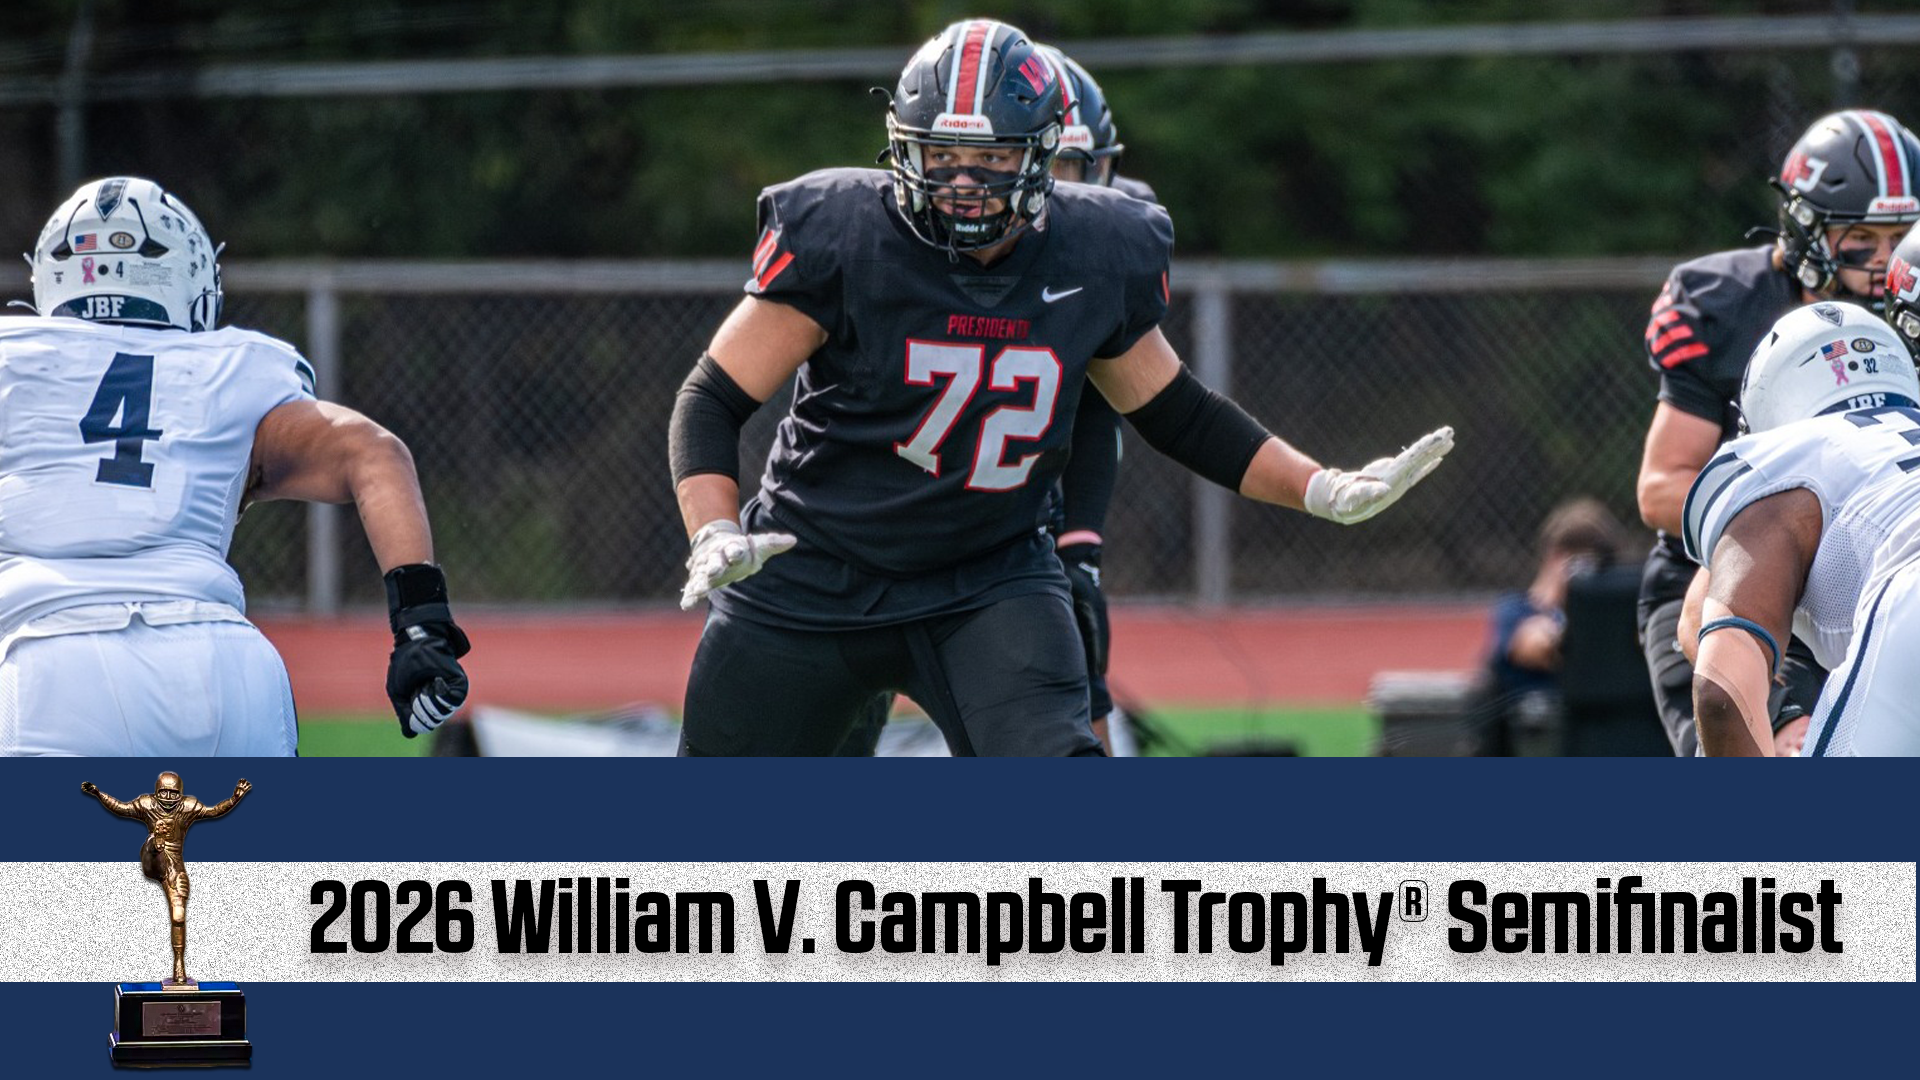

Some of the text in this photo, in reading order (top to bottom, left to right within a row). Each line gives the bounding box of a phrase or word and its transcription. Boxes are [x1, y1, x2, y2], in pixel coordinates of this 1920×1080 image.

[115, 260, 124, 279] 4
[81, 296, 125, 319] JBF
[1863, 357, 1879, 374] 32
[79, 351, 163, 489] 4
[893, 337, 1063, 493] 72
